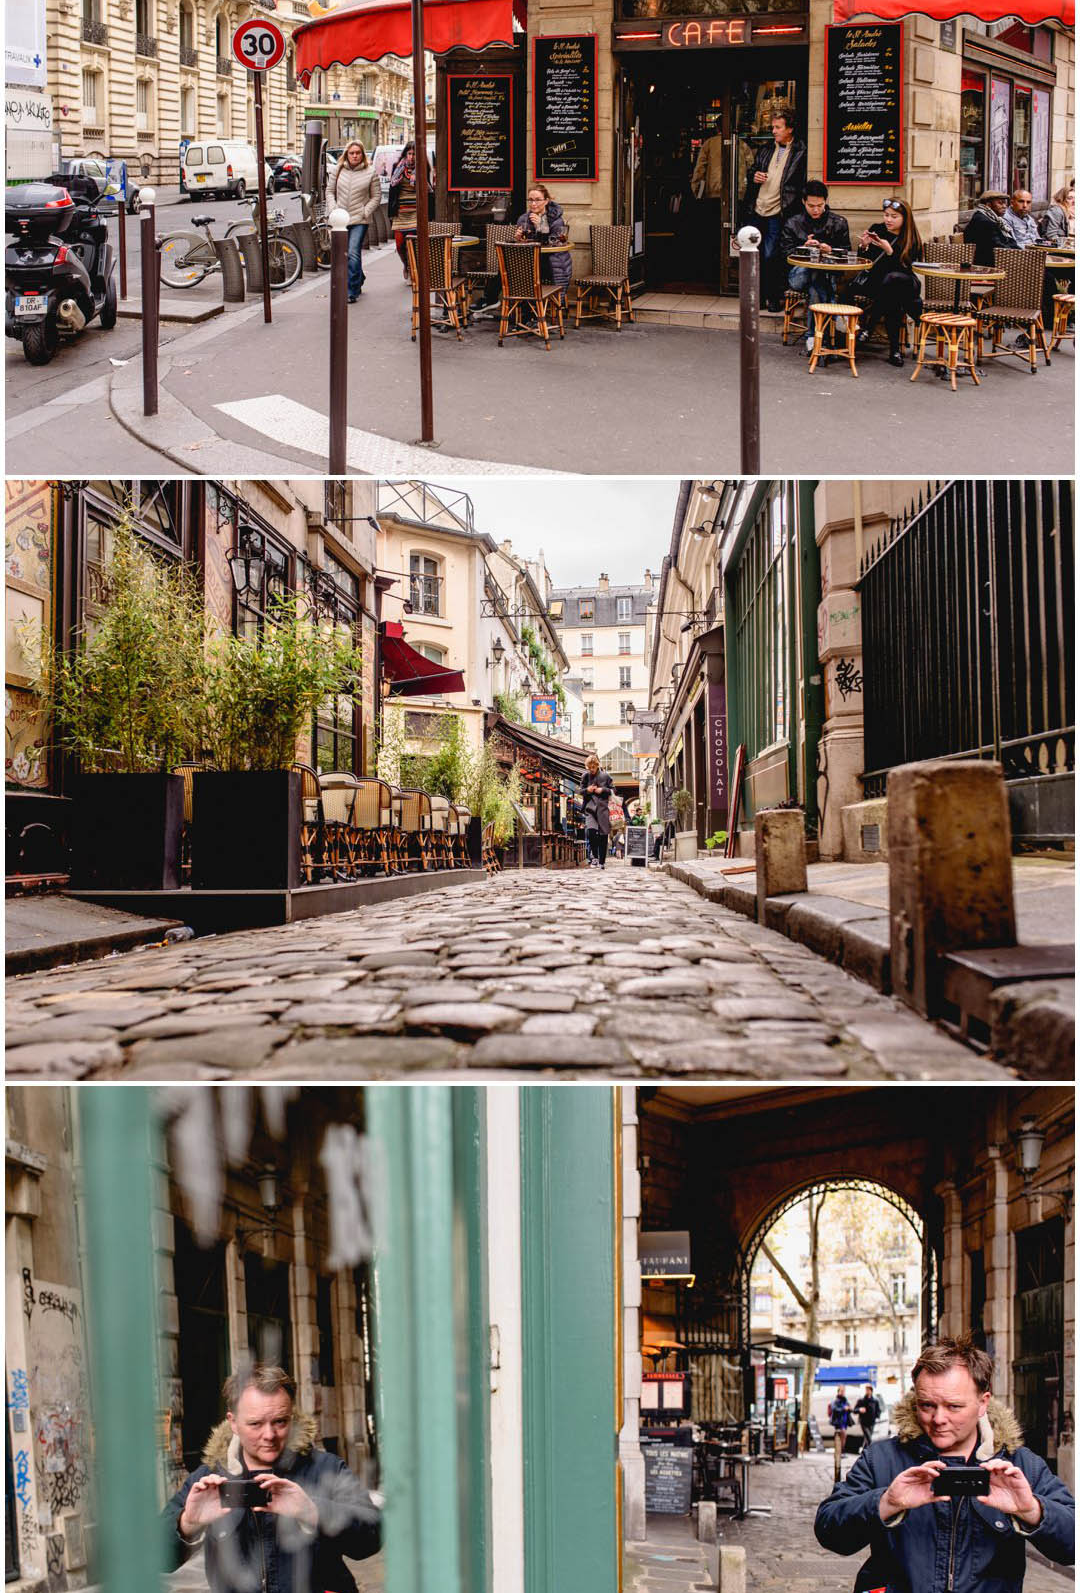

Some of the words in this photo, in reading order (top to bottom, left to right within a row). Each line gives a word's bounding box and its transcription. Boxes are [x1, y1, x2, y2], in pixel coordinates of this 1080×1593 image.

[243, 33, 275, 56] 30
[668, 20, 746, 46] CAFE
[714, 719, 723, 796] CHOCOLAT
